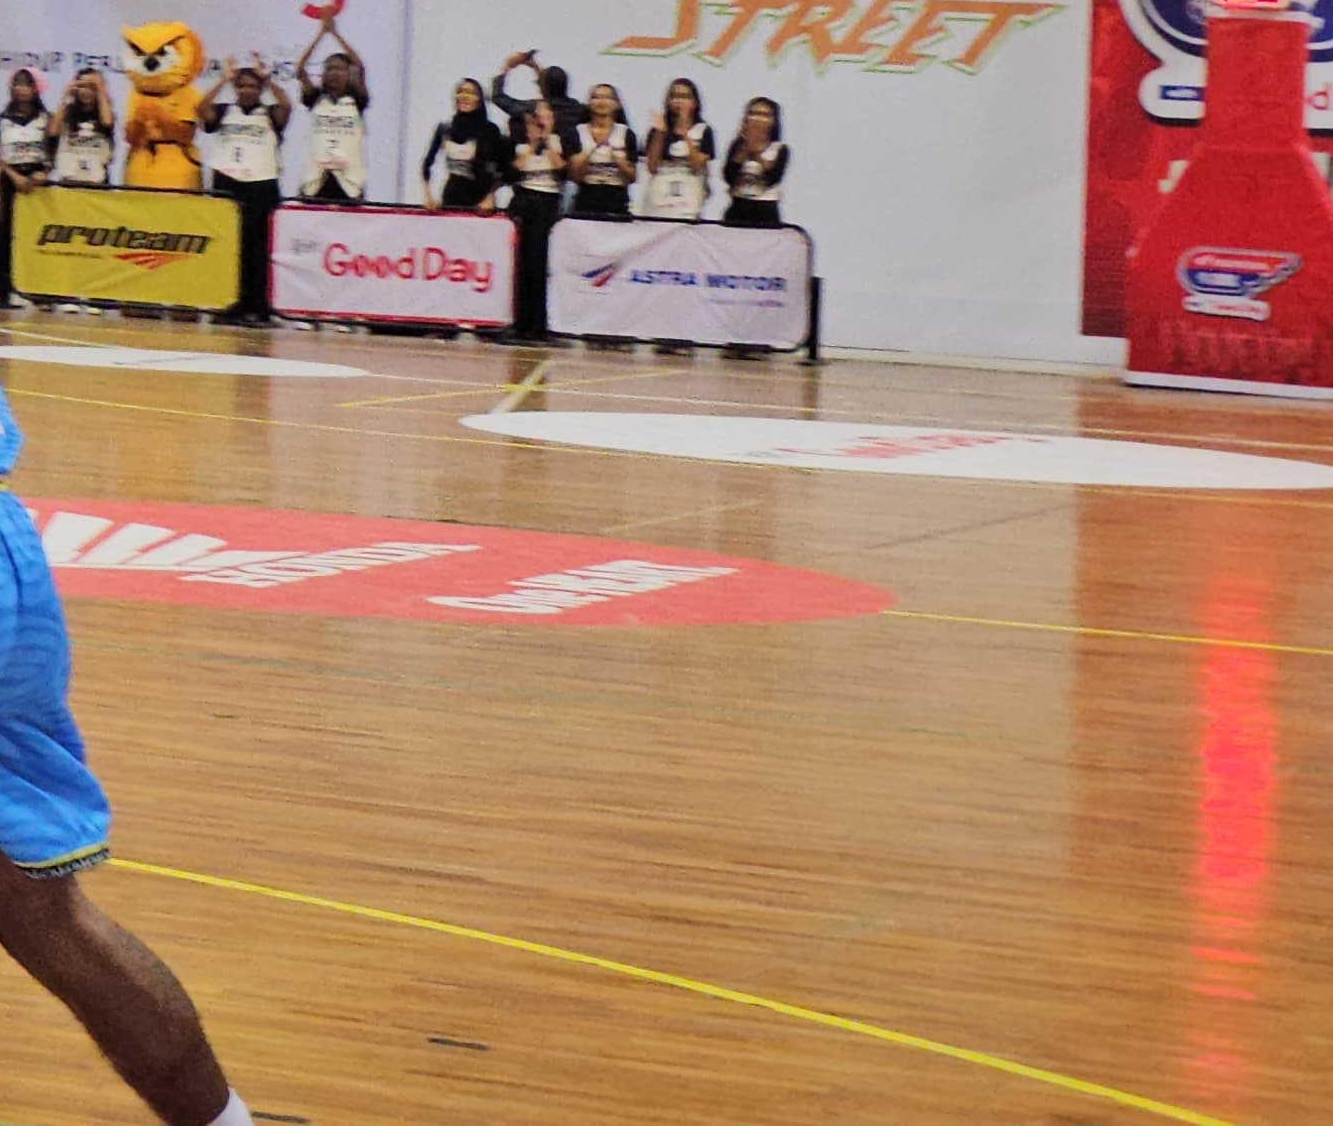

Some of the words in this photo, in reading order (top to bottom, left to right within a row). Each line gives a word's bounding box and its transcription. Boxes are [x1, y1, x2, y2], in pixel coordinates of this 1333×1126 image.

[36, 223, 215, 255] proteam
[629, 269, 699, 286] ASTRA
[704, 273, 789, 292] MOTOR
